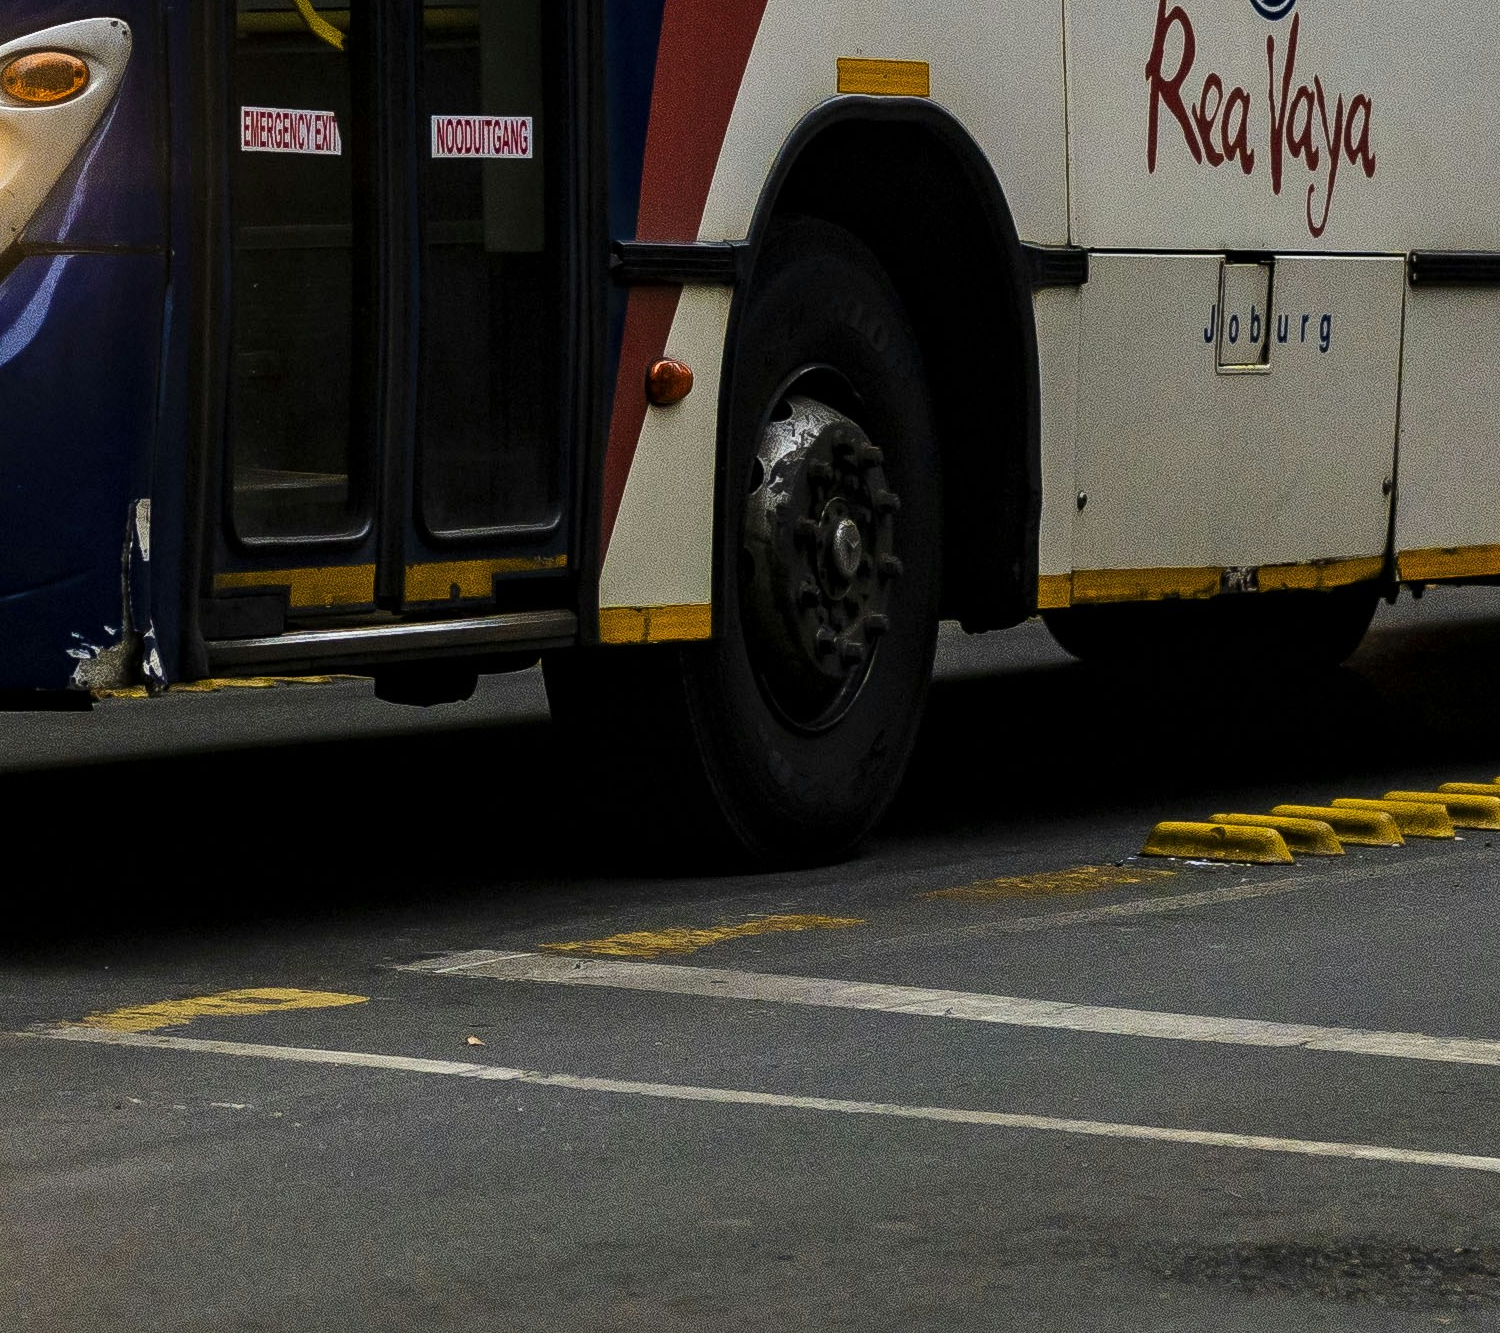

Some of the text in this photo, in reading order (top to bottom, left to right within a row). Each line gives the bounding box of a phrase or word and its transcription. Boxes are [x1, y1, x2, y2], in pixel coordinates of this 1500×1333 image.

[243, 109, 340, 152] EMERGENCY EXIT
[435, 117, 529, 156] NOODUITGANG
[1266, 11, 1376, 239] Vaya
[1203, 303, 1332, 354] Joburg
